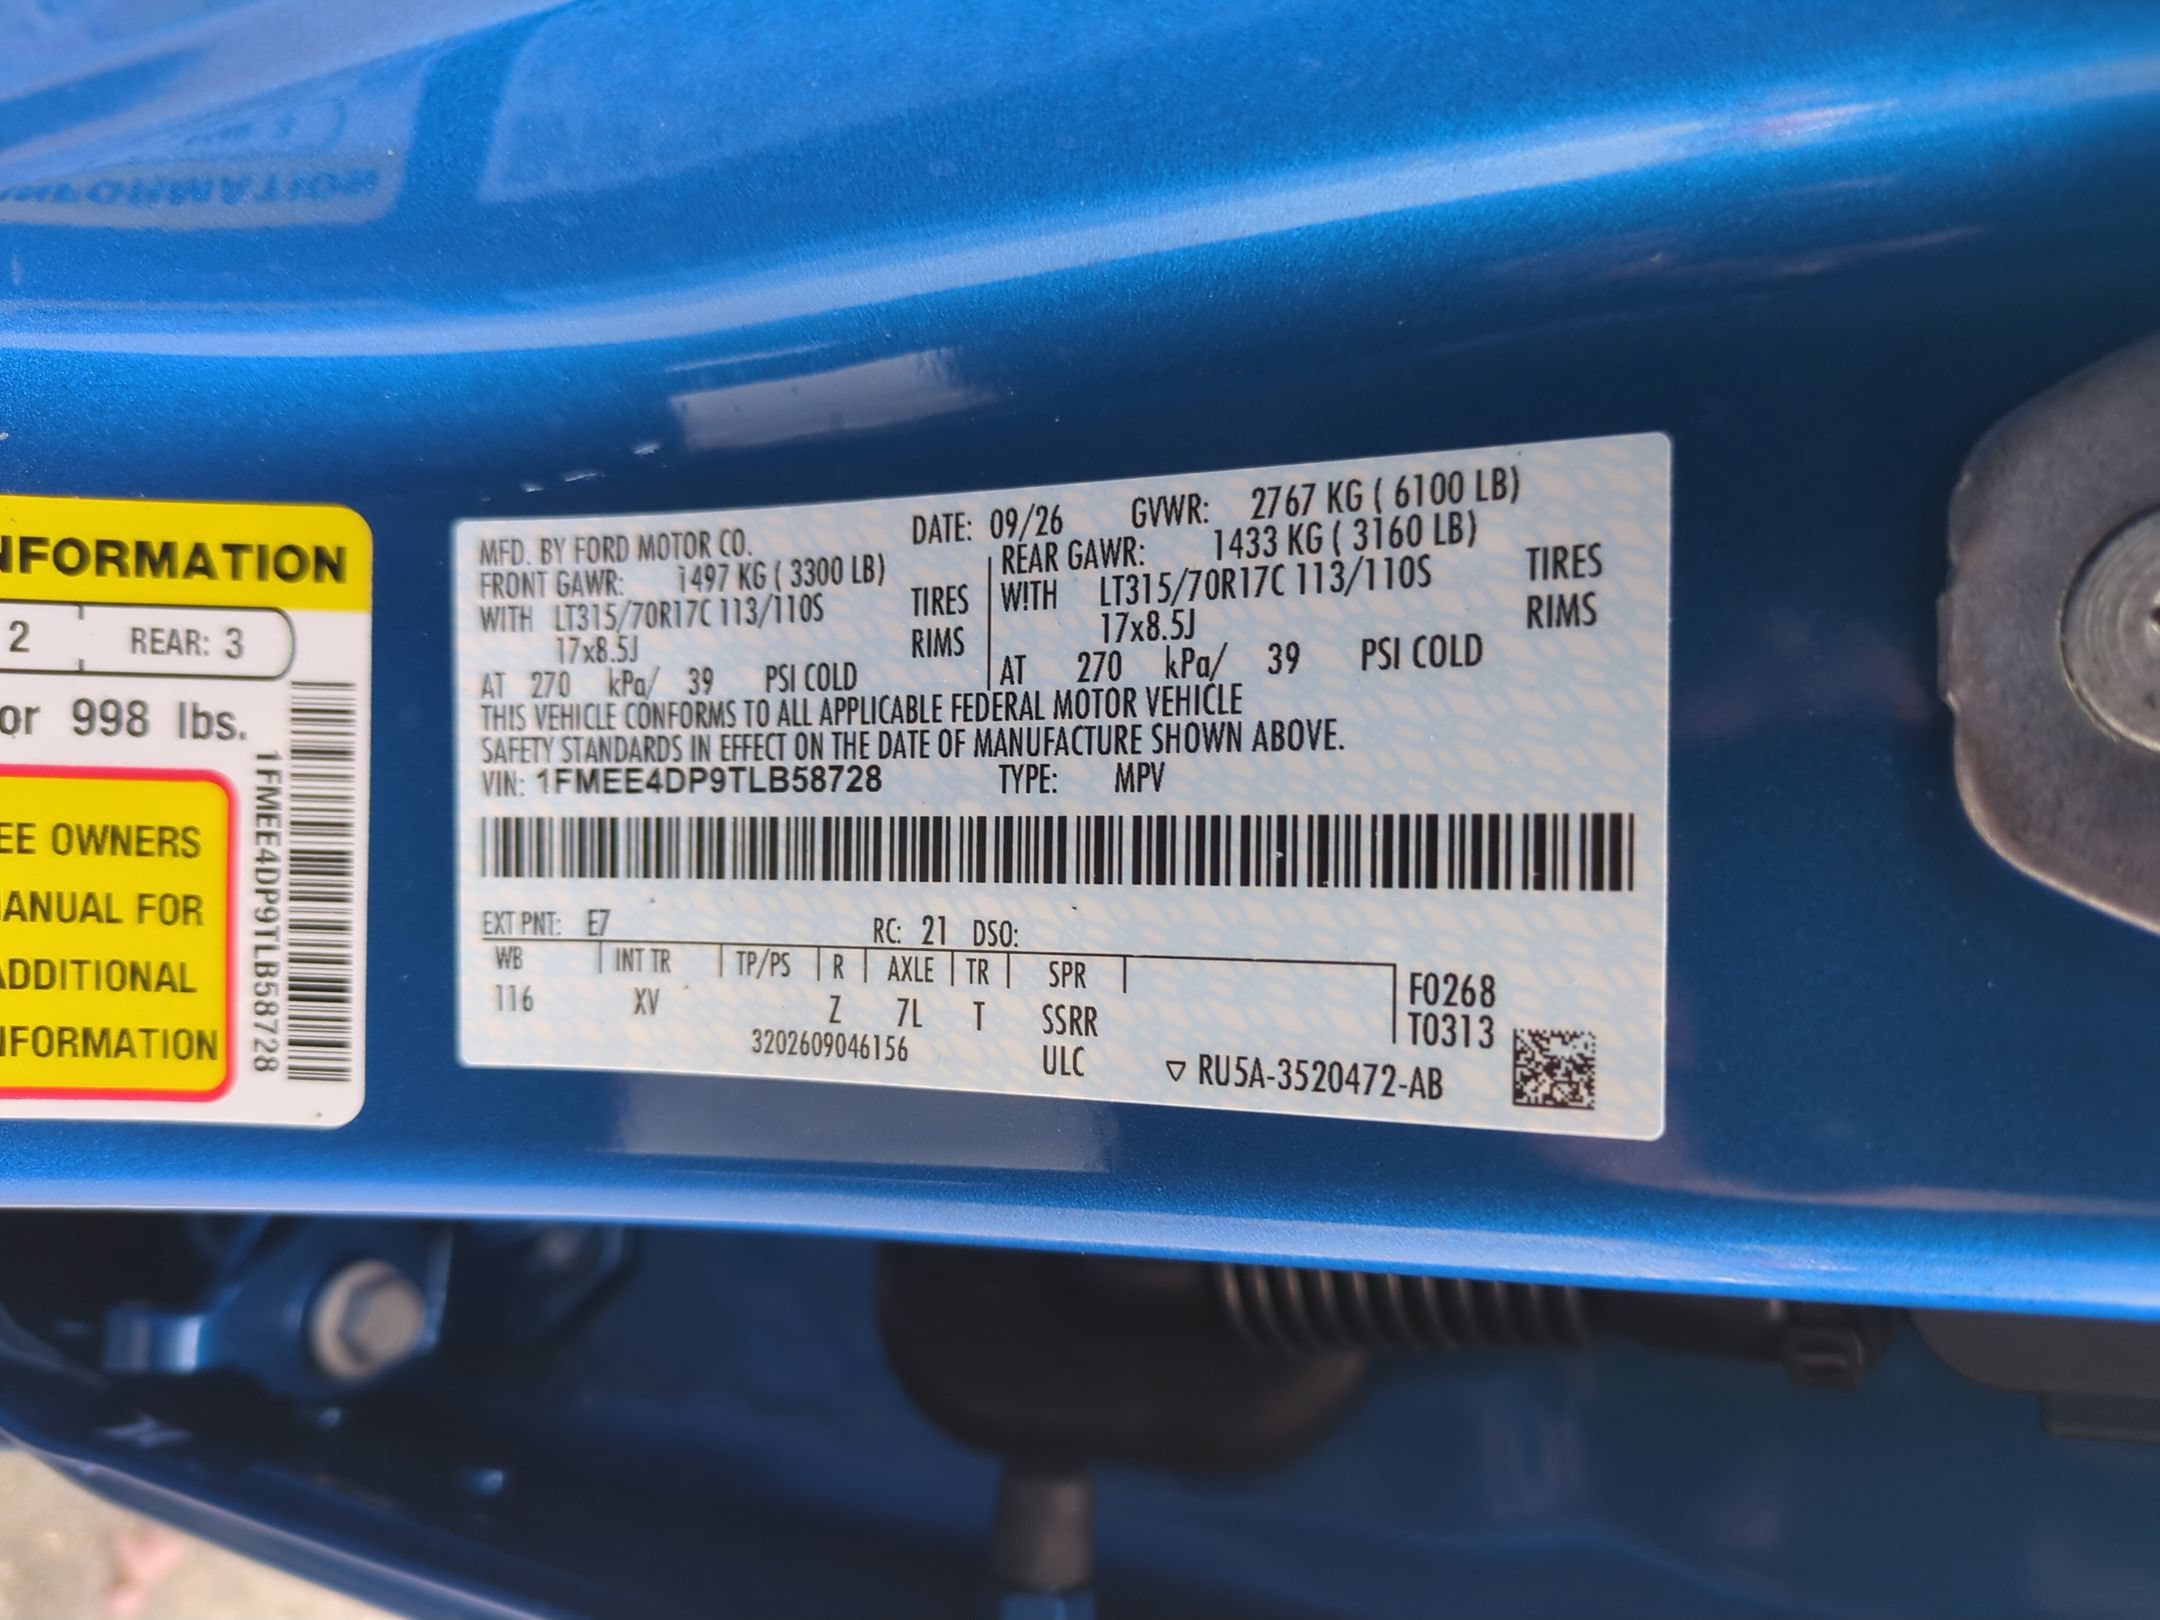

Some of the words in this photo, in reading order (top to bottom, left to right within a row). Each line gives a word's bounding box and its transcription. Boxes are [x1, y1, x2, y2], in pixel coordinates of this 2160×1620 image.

[1132, 493, 1209, 529] GVWR:
[1251, 482, 1317, 520] 2767
[1327, 478, 1363, 514] KG
[1395, 470, 1464, 509] 6100
[912, 512, 972, 545] DATE:
[990, 503, 1063, 542] 09/26
[479, 538, 531, 566] MFD.
[540, 537, 566, 565] BY
[574, 534, 629, 564] FORD
[638, 530, 711, 562] MOTOR
[718, 528, 752, 557] CO.
[1002, 541, 1059, 575] REAR
[1068, 536, 1144, 570] GAWR:
[1214, 524, 1277, 561] 1433
[1288, 521, 1323, 556] KG
[1353, 513, 1423, 551] 3160
[480, 570, 548, 599] FRONT
[556, 568, 623, 598] GAWR:
[678, 563, 730, 593] 1497
[738, 560, 767, 591] KG
[790, 555, 843, 588] 3300
[1525, 542, 1603, 581] TIRES
[1100, 563, 1286, 607] LT315/70R17C
[1297, 553, 1432, 597] 113/110S
[479, 605, 532, 632] WITH
[554, 598, 711, 632] LT315/70R17C
[720, 592, 824, 629] 113/110S
[910, 583, 969, 617] TIRES
[1527, 591, 1597, 629] RIMS
[9, 620, 29, 653] 2
[912, 625, 965, 658] RIMS
[1101, 608, 1195, 644] 17x8.5J
[131, 627, 208, 656] REAR:
[225, 627, 243, 660] 3
[556, 636, 639, 664] 17x8.5J
[999, 654, 1027, 686] AT
[1076, 650, 1122, 683] 270
[1165, 642, 1228, 682] kPa/
[1267, 641, 1300, 675] 39
[1361, 636, 1400, 671] PSI
[1412, 633, 1483, 669] COLD
[481, 672, 505, 699] AT
[530, 670, 570, 699] 270
[608, 666, 660, 700] kPa/
[688, 666, 714, 696] 39
[765, 663, 795, 693] PSI
[804, 661, 857, 692] COLD
[0, 705, 40, 738] or
[72, 698, 149, 738] 998
[178, 702, 246, 741] lbs.
[480, 704, 526, 731] THIS
[534, 702, 616, 731] VEHICLE
[624, 699, 736, 730] CONFORMS
[743, 698, 770, 728] TO
[776, 698, 813, 727] ALL
[819, 694, 943, 726] APPLICABLE
[952, 690, 1046, 723] FEDERAL
[1053, 686, 1137, 720] MOTOR
[1145, 683, 1243, 717] VEHICLE
[481, 736, 555, 764] SAFETY
[560, 734, 683, 764] STANDARDS
[690, 734, 711, 763] IN
[720, 732, 787, 762] EFFECT
[794, 731, 823, 761] ON
[831, 731, 870, 760] THE
[878, 729, 930, 759] DATE
[938, 728, 966, 758] OF
[974, 724, 1142, 758] MANUFACTURE
[1151, 721, 1242, 754] SHOWN
[1251, 718, 1344, 752] ABOVE.
[482, 770, 524, 797] VIN:
[536, 764, 882, 794] 1FMEE4DP9TLB58728
[998, 763, 1057, 794] TYPE:
[1115, 761, 1165, 793] MPV
[51, 823, 200, 859] OWNERS
[3, 890, 123, 924] ANUAL
[137, 893, 203, 926] FOR
[253, 750, 282, 1072] 1FMEE4DP9TLB58728
[482, 911, 516, 935] EXT
[520, 911, 561, 936] PNT:
[586, 909, 611, 936] E7
[874, 917, 901, 944] RC:
[921, 914, 945, 945] 21
[973, 919, 1018, 948] DSO:
[495, 946, 523, 970] WB
[615, 948, 645, 972] INT
[650, 948, 671, 973] TR
[736, 948, 791, 979] TP/PS
[833, 953, 844, 979] R
[887, 955, 934, 983] AXLE
[966, 958, 989, 985] TR
[1049, 961, 1087, 989] SPR
[0, 958, 197, 993] DDITIONAL
[496, 984, 533, 1012] 116
[634, 988, 660, 1015] XV
[829, 995, 841, 1024] Z
[897, 998, 923, 1028] 7L
[973, 1001, 985, 1031] T
[1042, 1003, 1098, 1037] SSRR
[0, 1025, 217, 1060] FORMATION
[752, 1028, 908, 1062] 3202609046156
[1043, 1044, 1086, 1077] ULC
[1199, 1053, 1443, 1100] RU5A-3520472-AB
